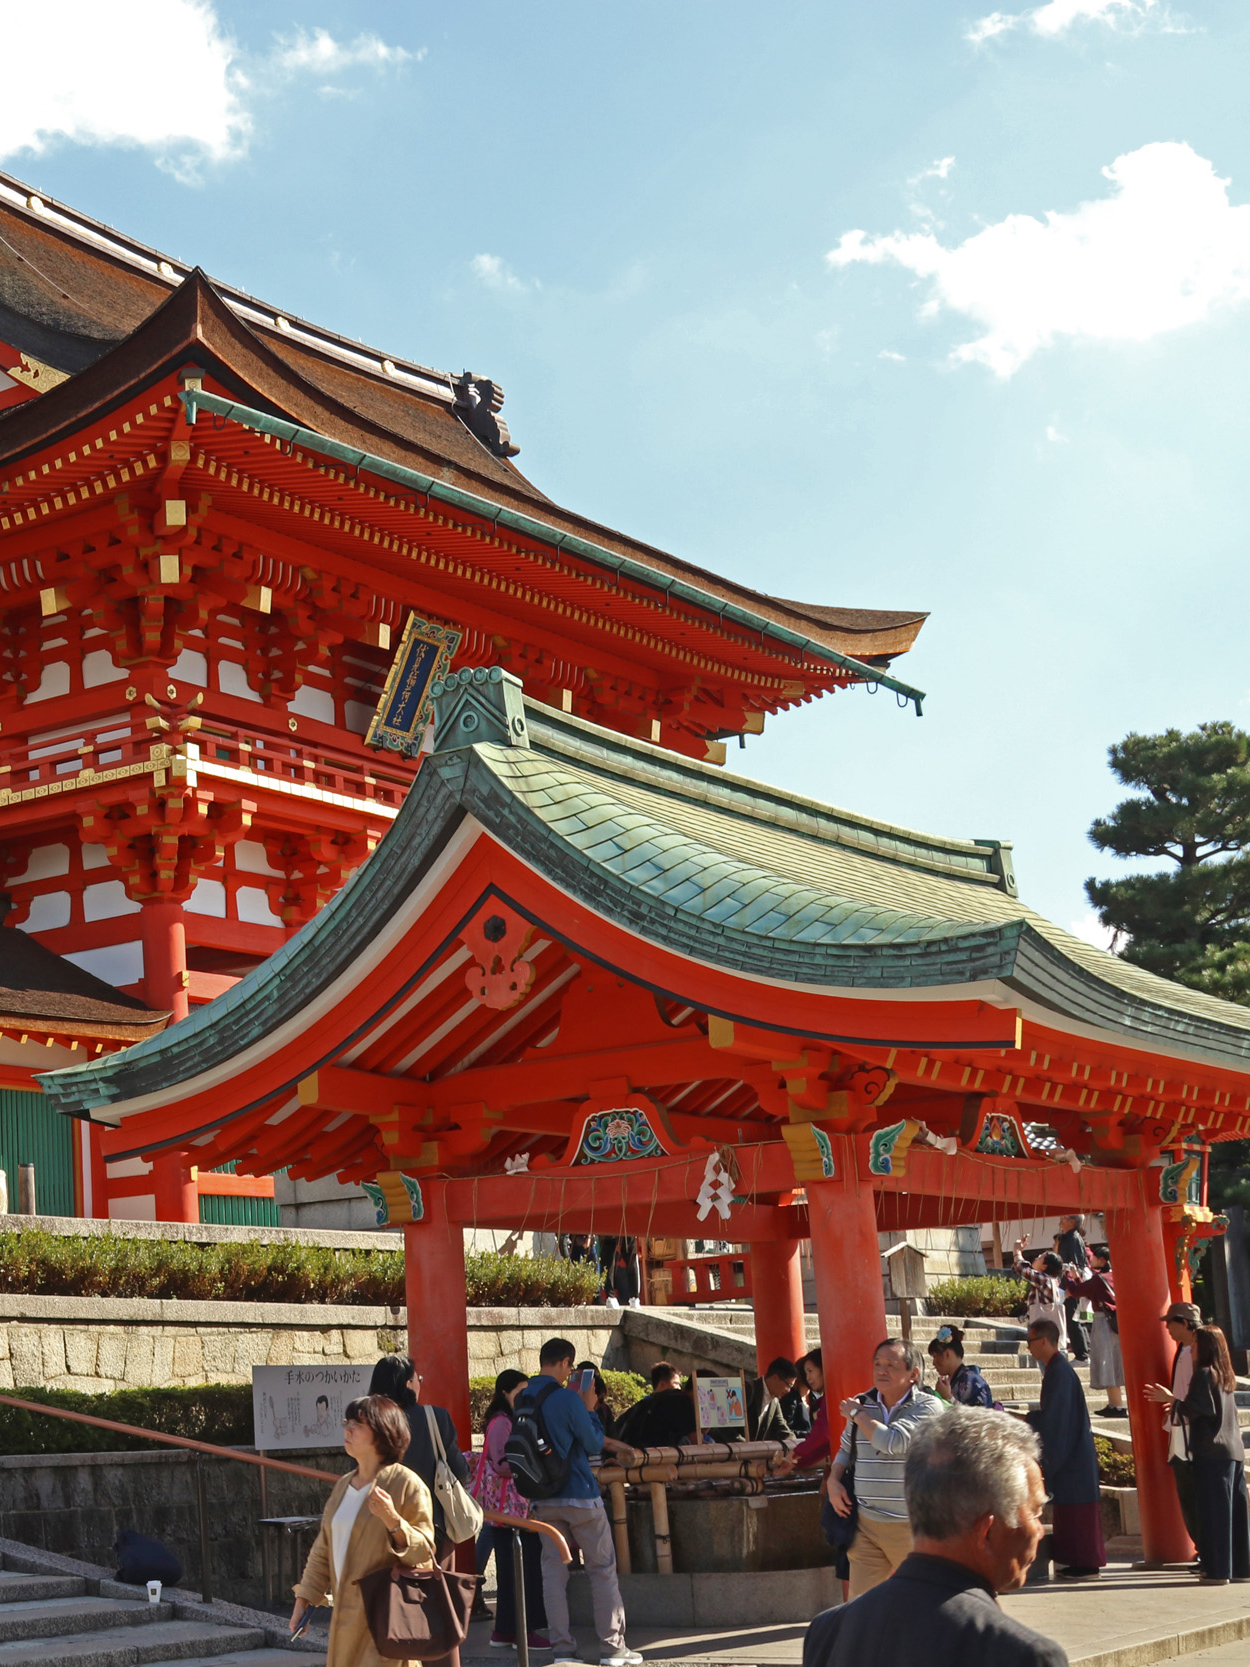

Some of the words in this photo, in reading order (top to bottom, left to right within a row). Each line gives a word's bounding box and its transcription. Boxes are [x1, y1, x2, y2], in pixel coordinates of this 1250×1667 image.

[284, 1370, 361, 1385] 手水のつかいかた
